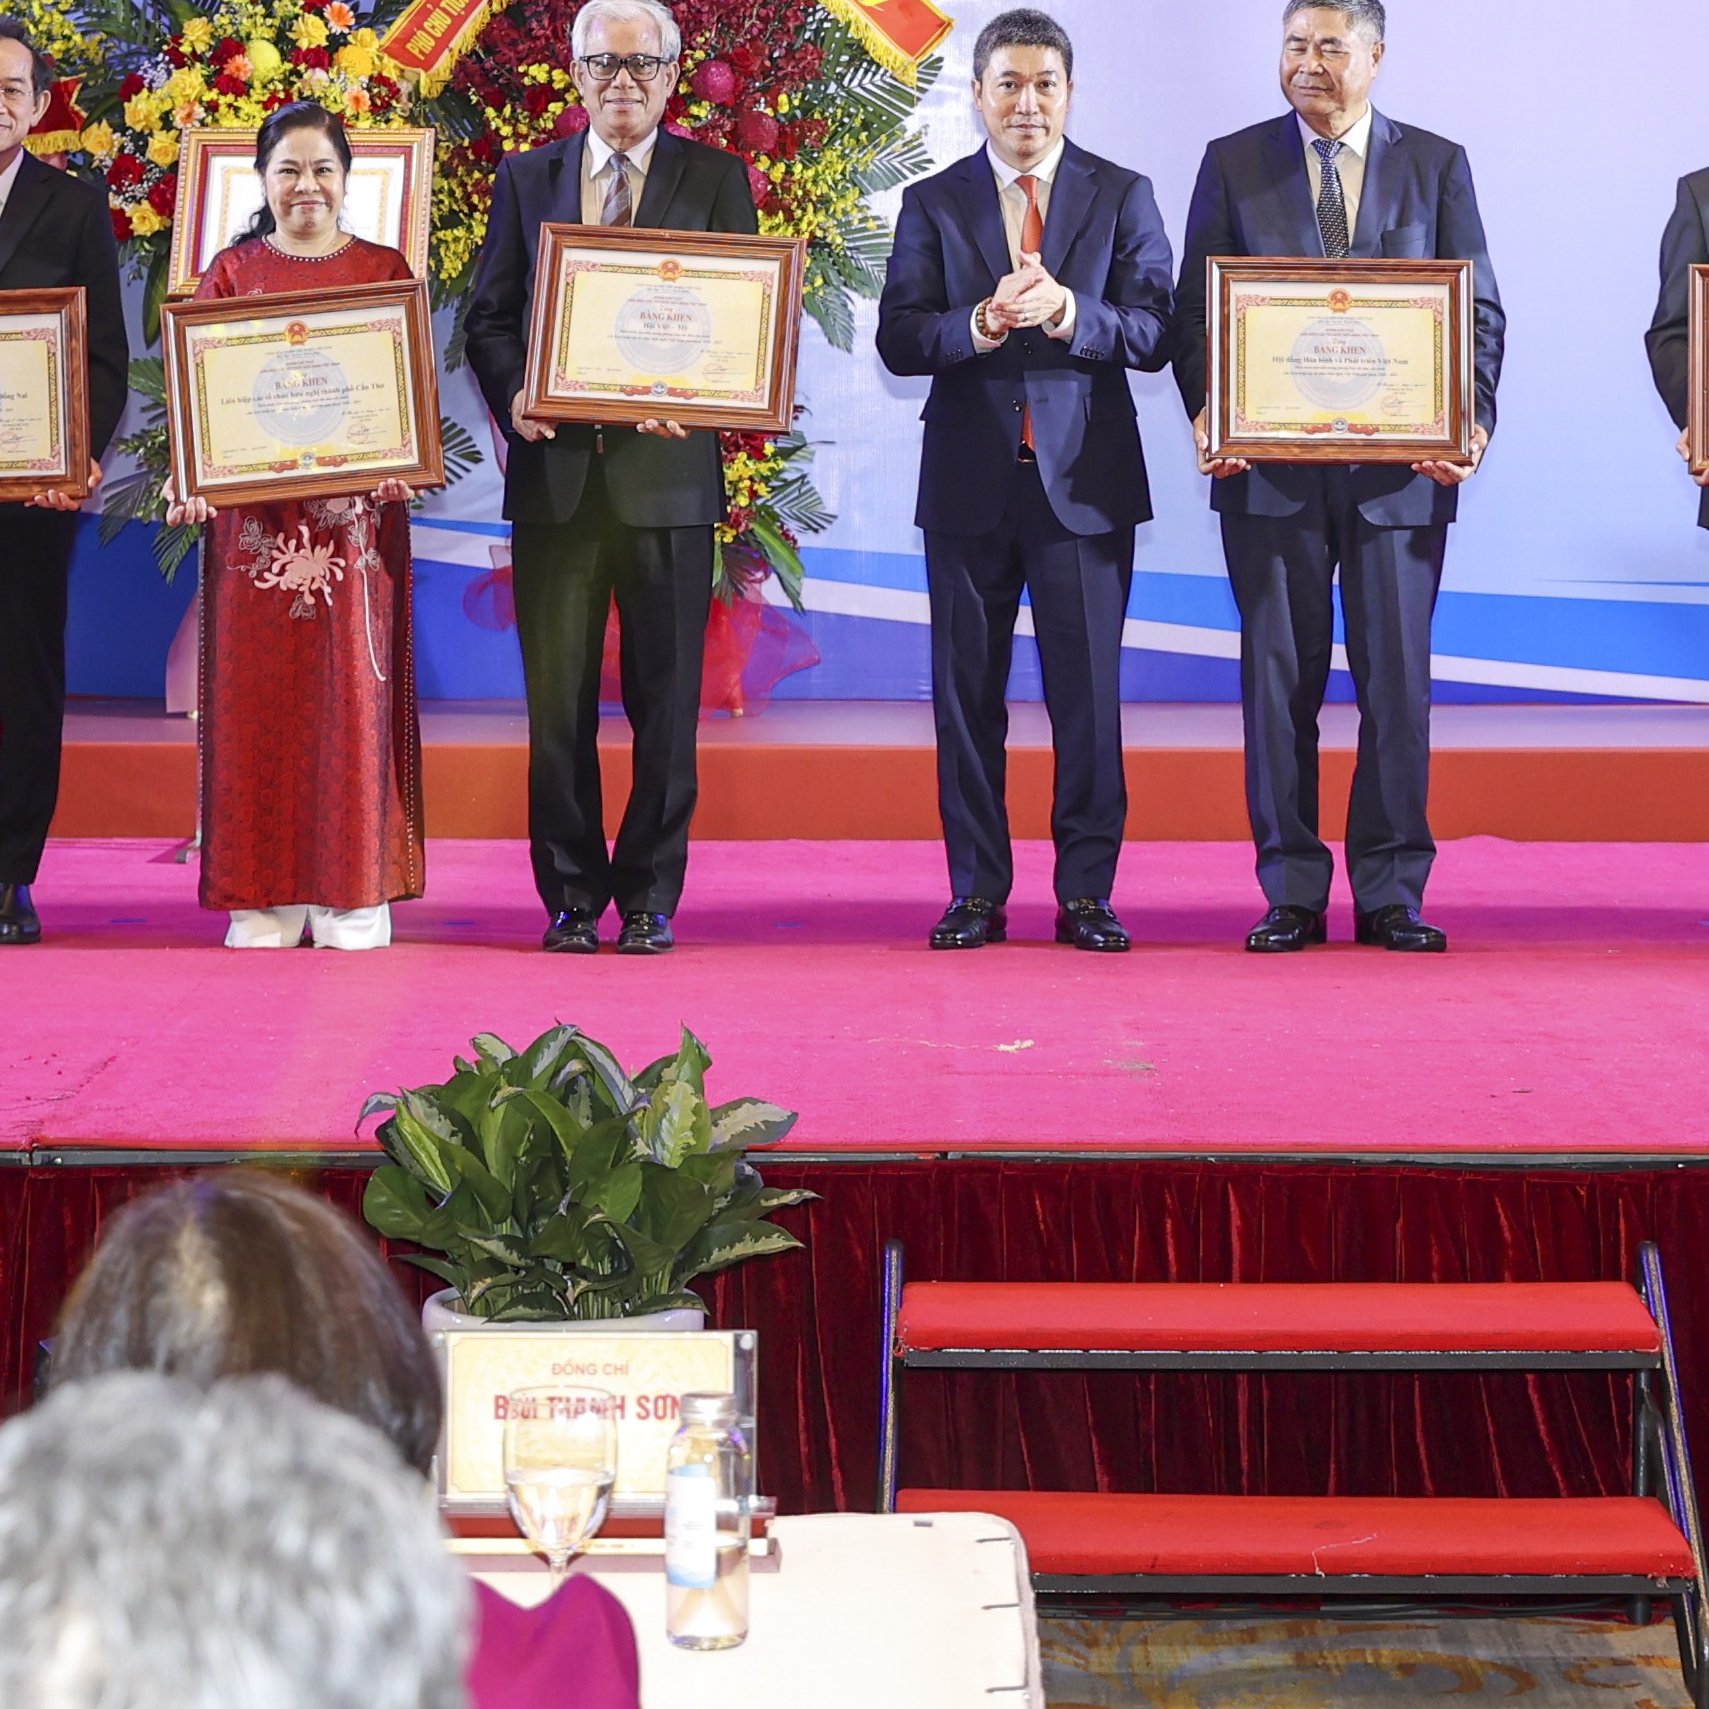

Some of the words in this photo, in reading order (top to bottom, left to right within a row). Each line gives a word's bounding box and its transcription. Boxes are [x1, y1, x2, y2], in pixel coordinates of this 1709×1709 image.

[405, 26, 434, 61] PHÓ
[422, 2, 452, 40] CHỦ
[1341, 345, 1366, 355] KHEN
[603, 1359, 630, 1375] CHÍ
